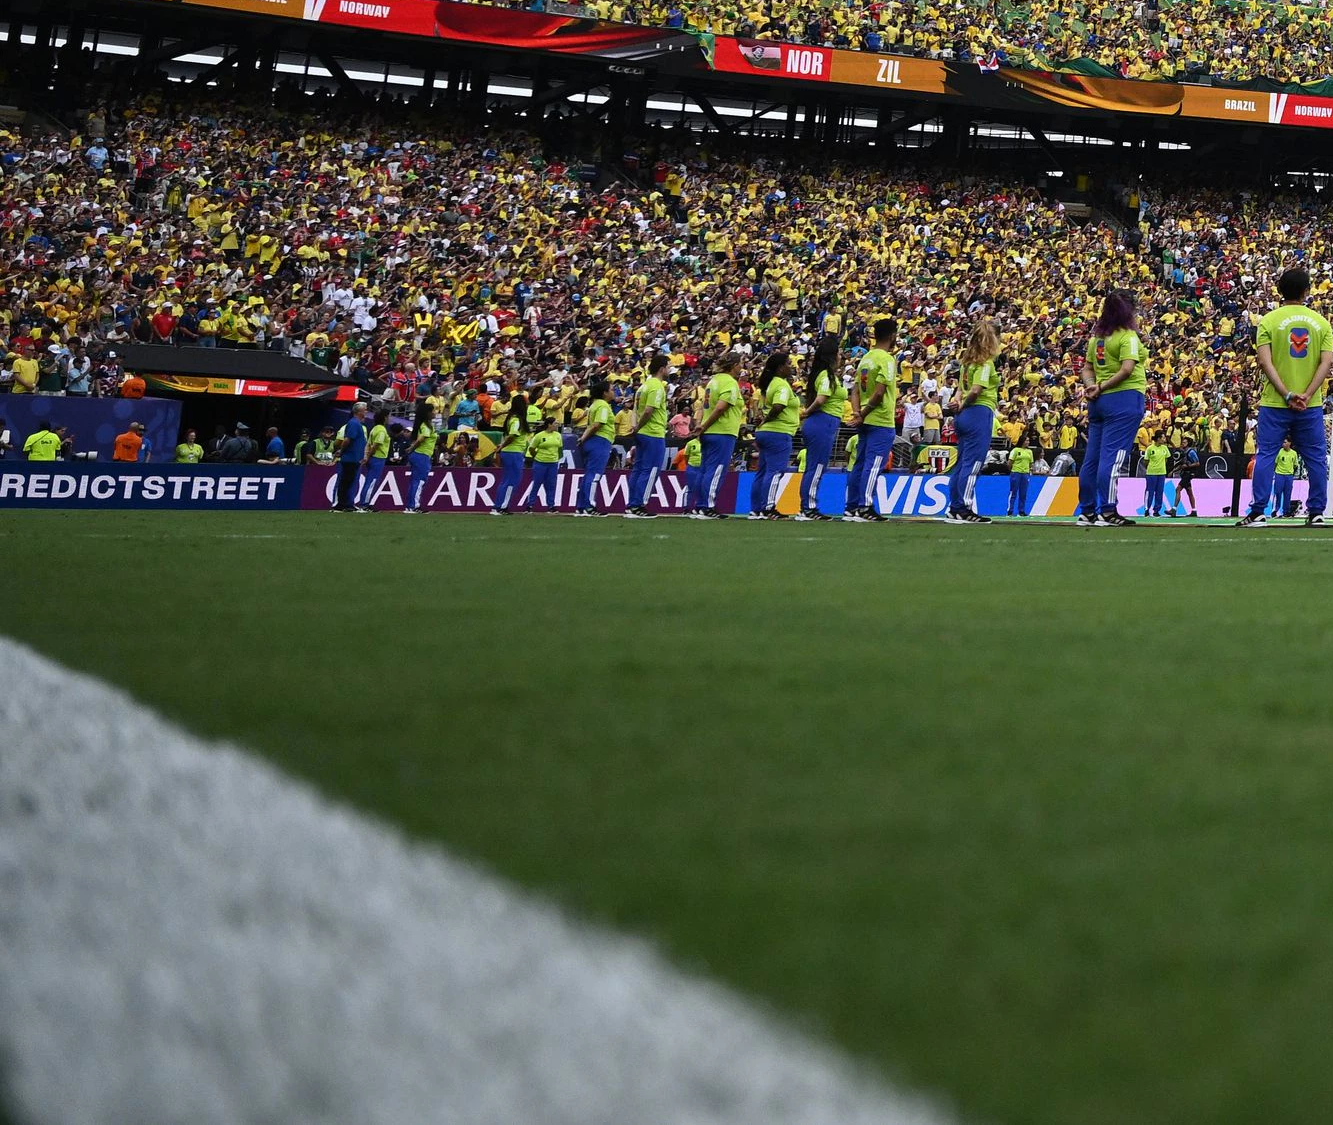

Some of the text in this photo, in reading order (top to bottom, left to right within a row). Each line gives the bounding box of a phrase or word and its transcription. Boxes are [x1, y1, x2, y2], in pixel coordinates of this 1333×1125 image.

[339, 0, 391, 19] NORWAY
[786, 49, 823, 75] NOR
[876, 59, 901, 83] ZIL
[1224, 92, 1333, 124] BRAZIL V NORWAY
[1278, 315, 1321, 332] VOLUNTEER
[876, 475, 975, 515] VIS
